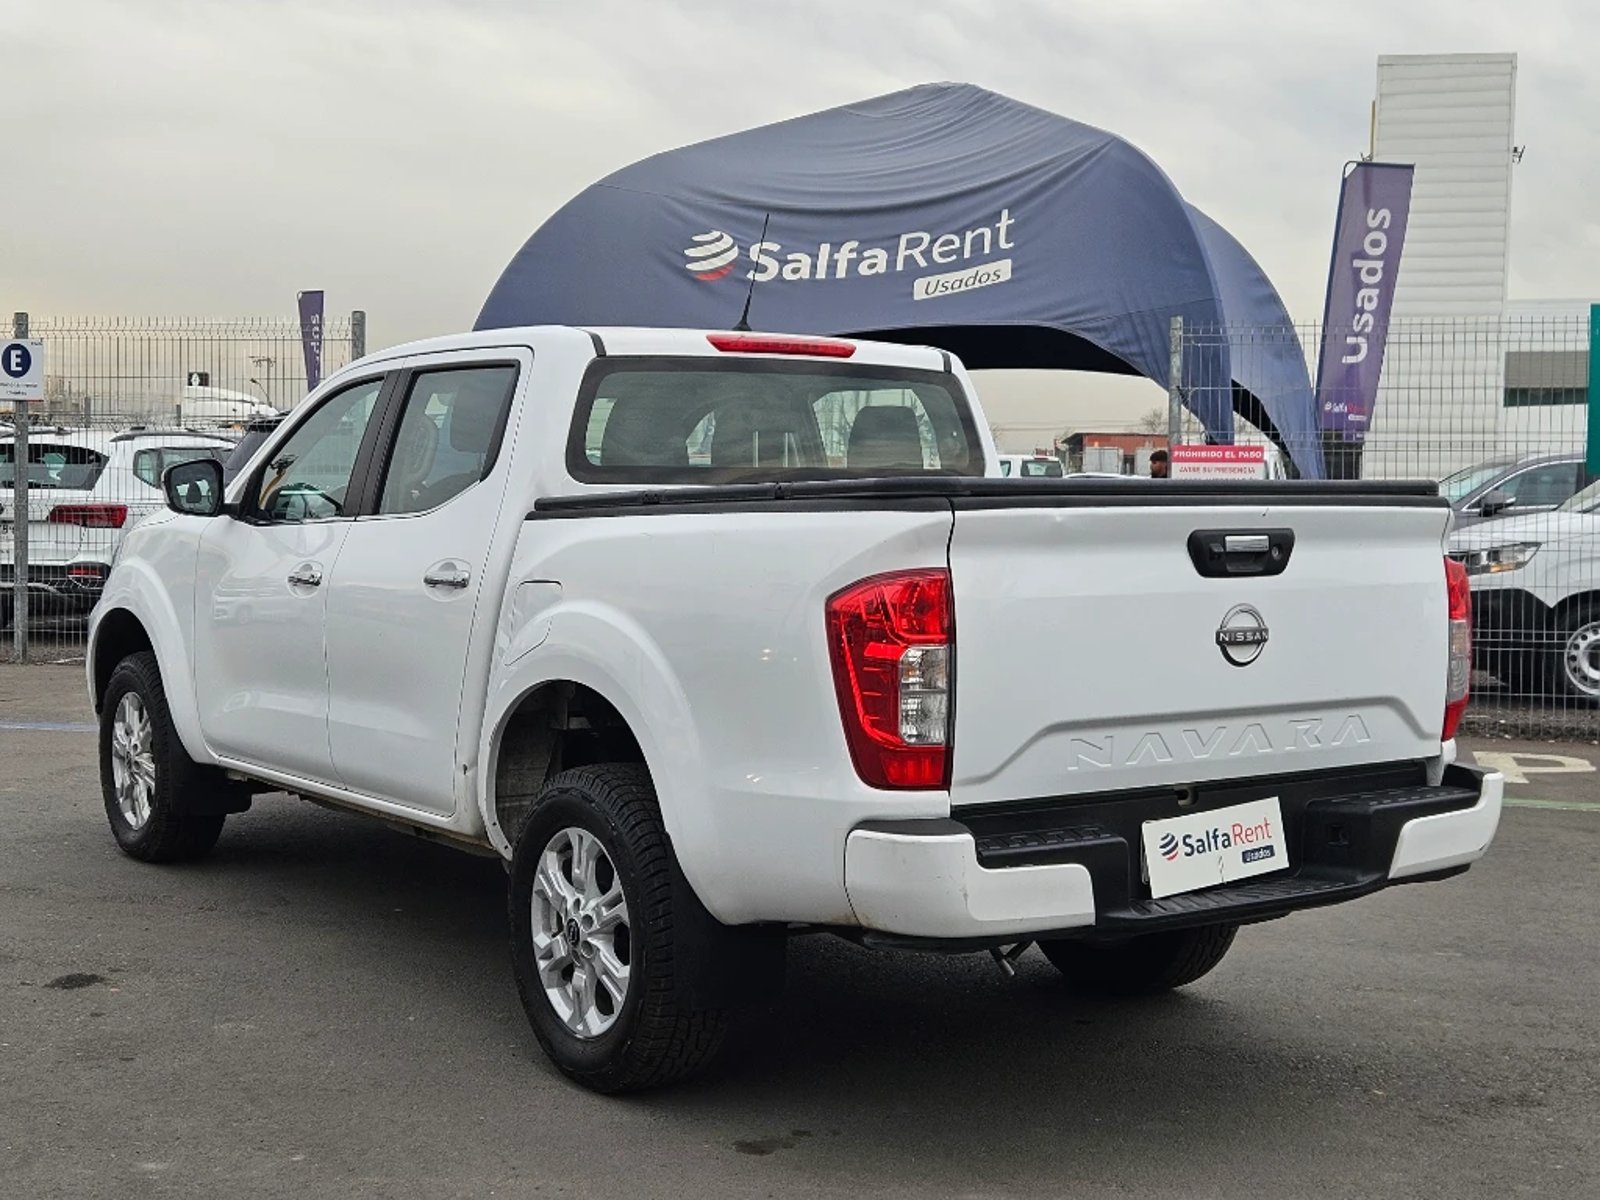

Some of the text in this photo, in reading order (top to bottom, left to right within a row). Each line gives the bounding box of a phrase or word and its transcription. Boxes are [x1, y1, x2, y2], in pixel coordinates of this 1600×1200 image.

[923, 266, 1002, 296] Usados
[1341, 207, 1391, 364] usados
[10, 349, 23, 371] E
[1173, 450, 1223, 458] PROHIBIDO
[1219, 630, 1268, 642] NISSAN
[1067, 714, 1370, 771] NAVARA
[1245, 848, 1271, 862] Usados
